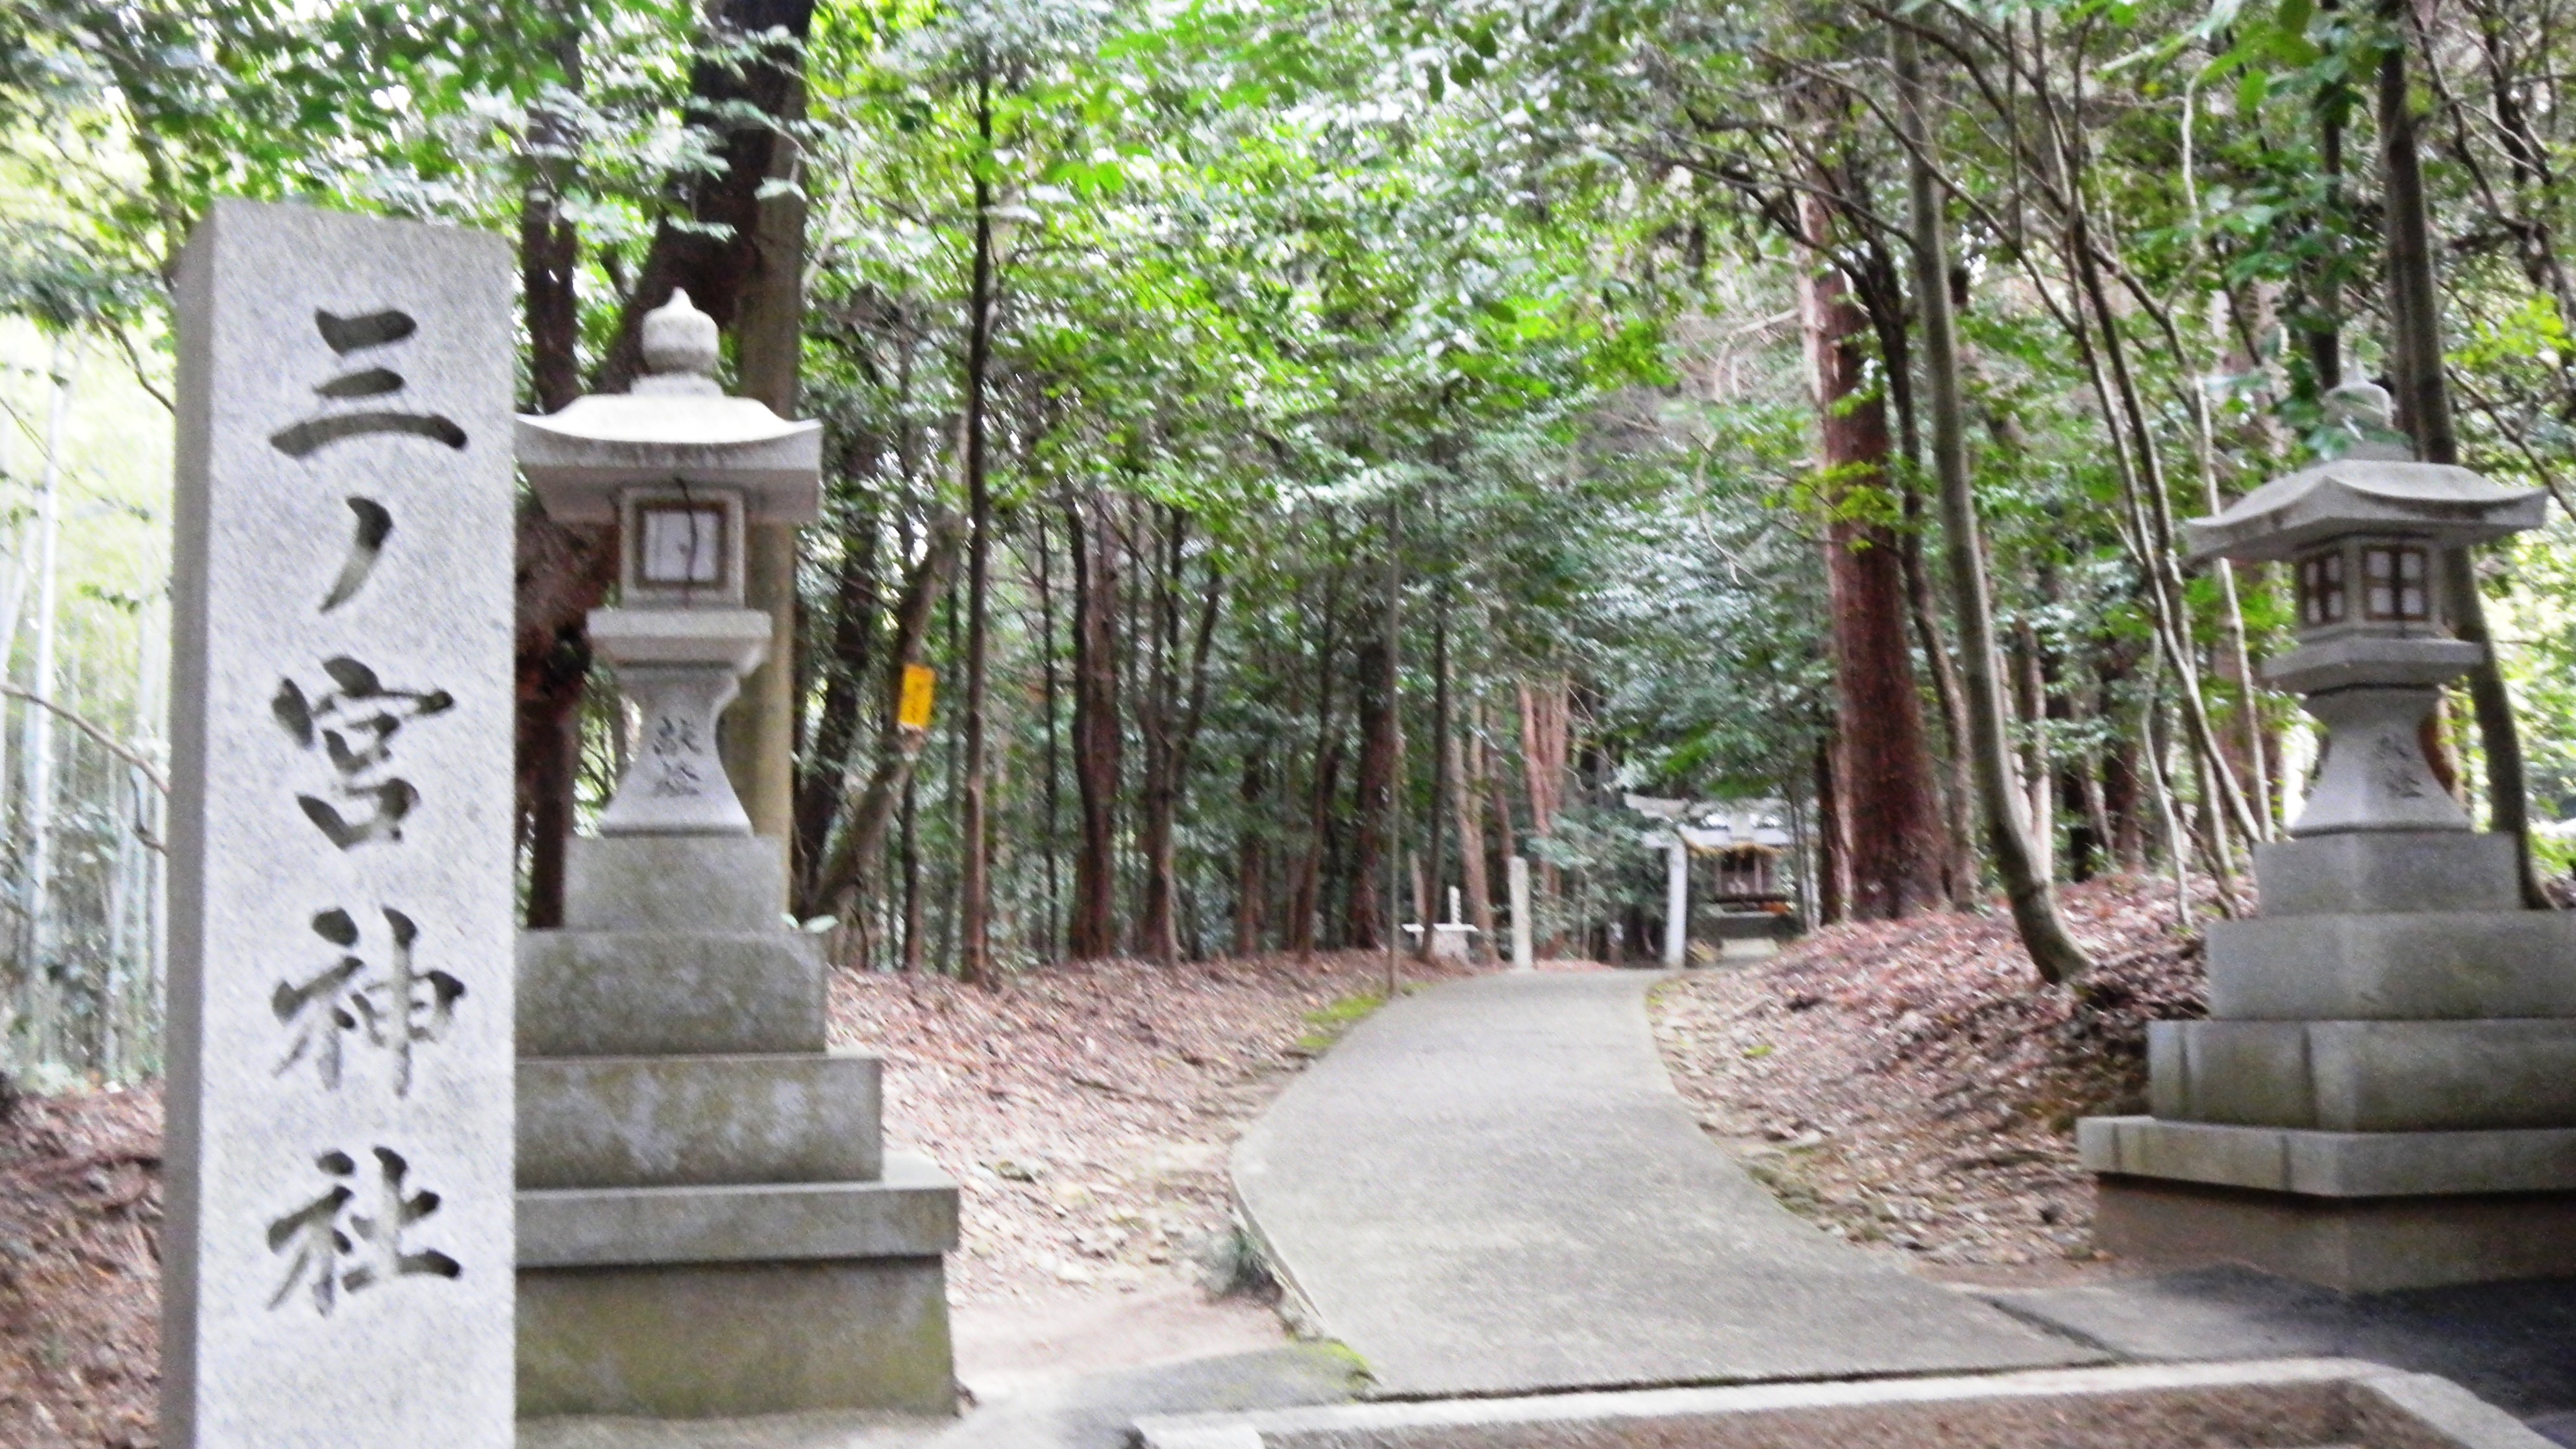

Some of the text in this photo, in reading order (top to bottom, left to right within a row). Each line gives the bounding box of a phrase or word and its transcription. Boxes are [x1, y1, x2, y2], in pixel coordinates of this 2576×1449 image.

[267, 306, 469, 1315] 三ノ宮神社
